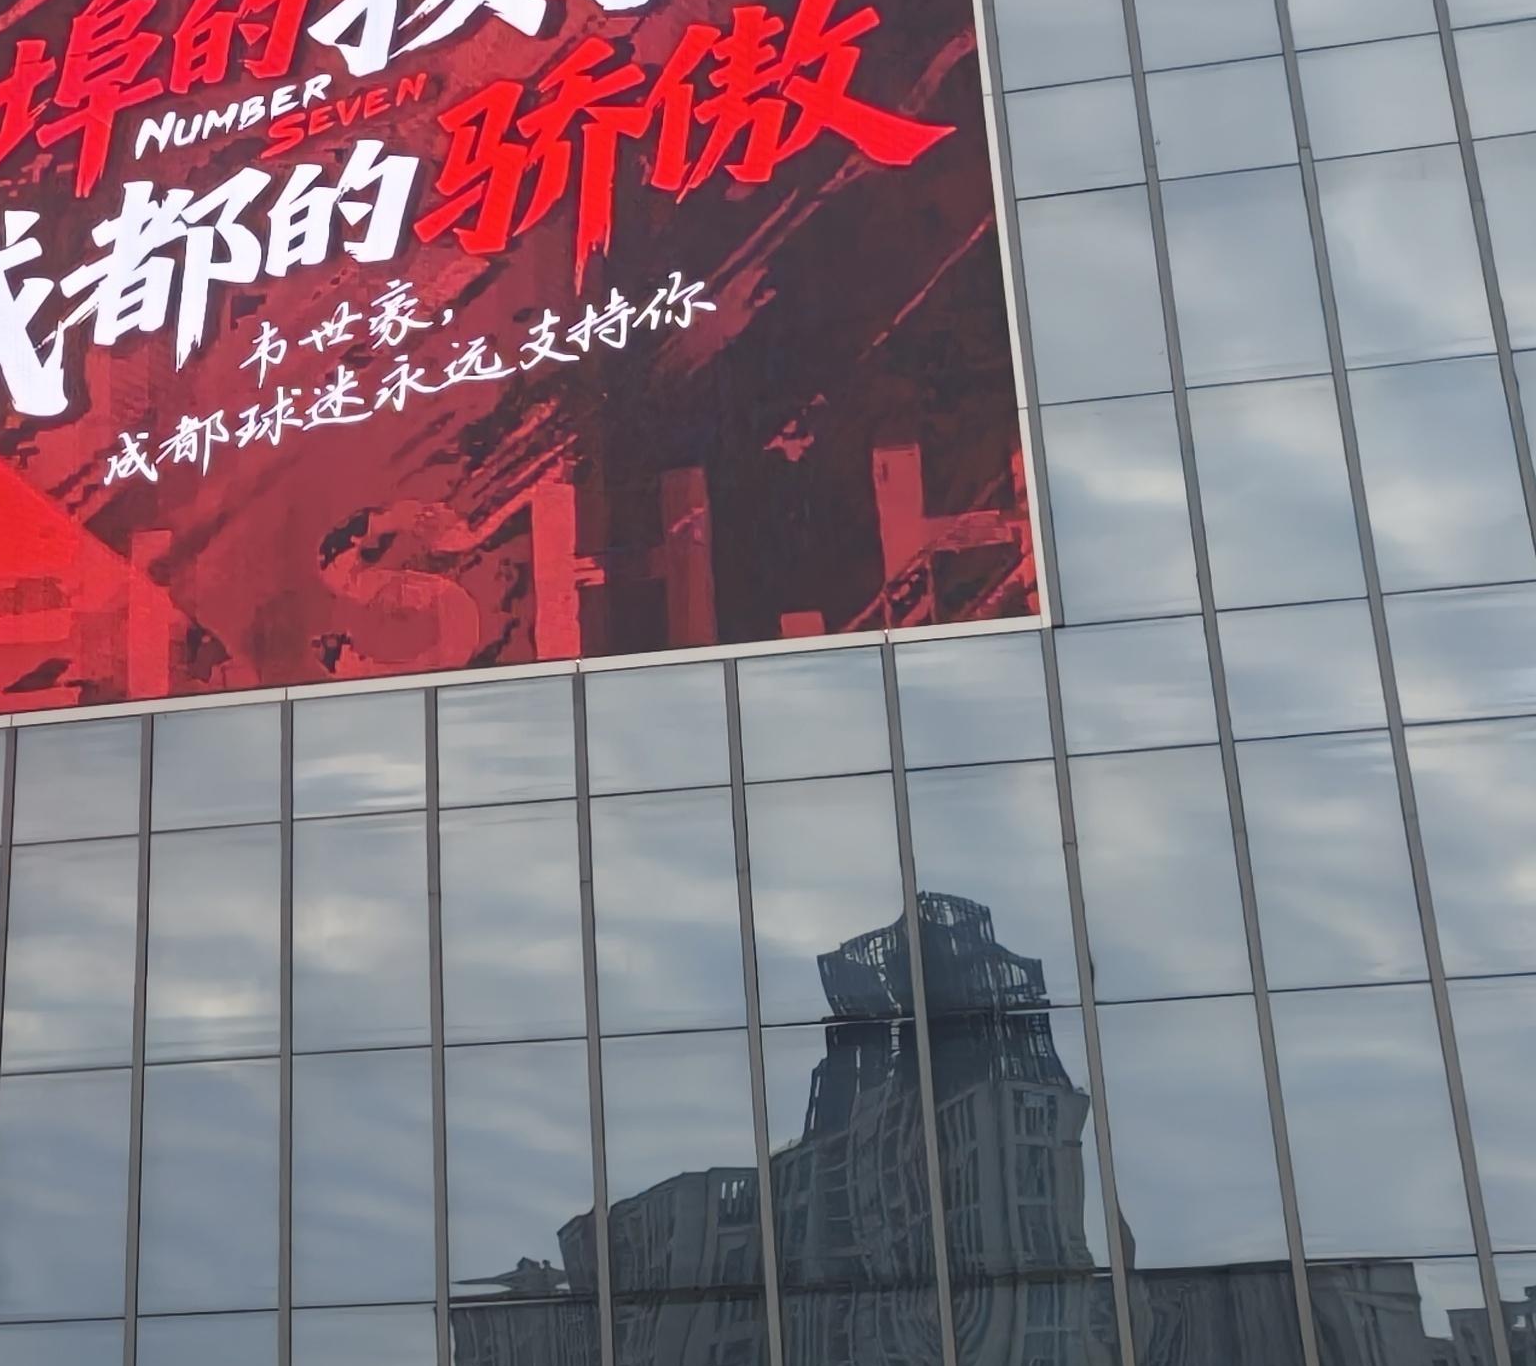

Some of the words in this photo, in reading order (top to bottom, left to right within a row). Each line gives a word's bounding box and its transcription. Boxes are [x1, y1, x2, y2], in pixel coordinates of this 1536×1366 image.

[135, 74, 332, 160] NUMBER
[260, 73, 426, 159] SEVEN
[103, 271, 717, 485] 成都球迷永远支持你
